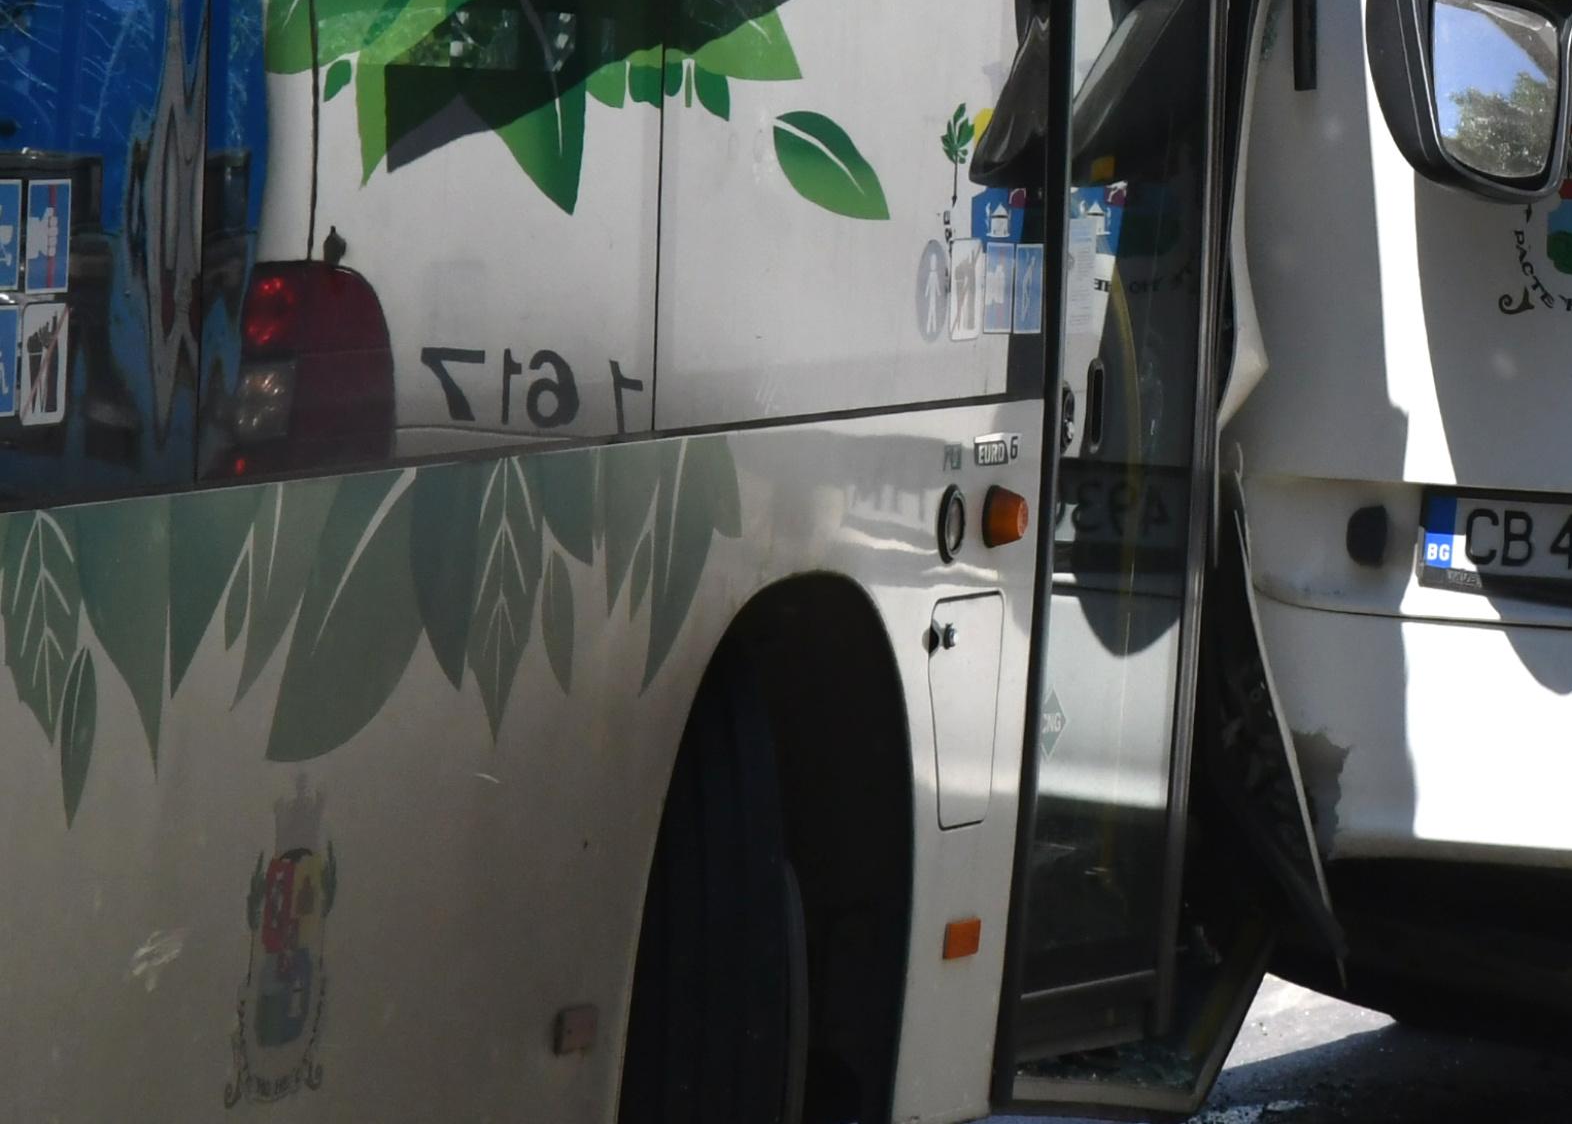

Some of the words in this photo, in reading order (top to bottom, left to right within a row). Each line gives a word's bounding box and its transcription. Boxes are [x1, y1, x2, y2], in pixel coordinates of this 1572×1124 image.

[977, 442, 1005, 465] EURO
[1009, 435, 1019, 460] 6
[1426, 542, 1451, 562] BG
[1463, 507, 1535, 568] CB
